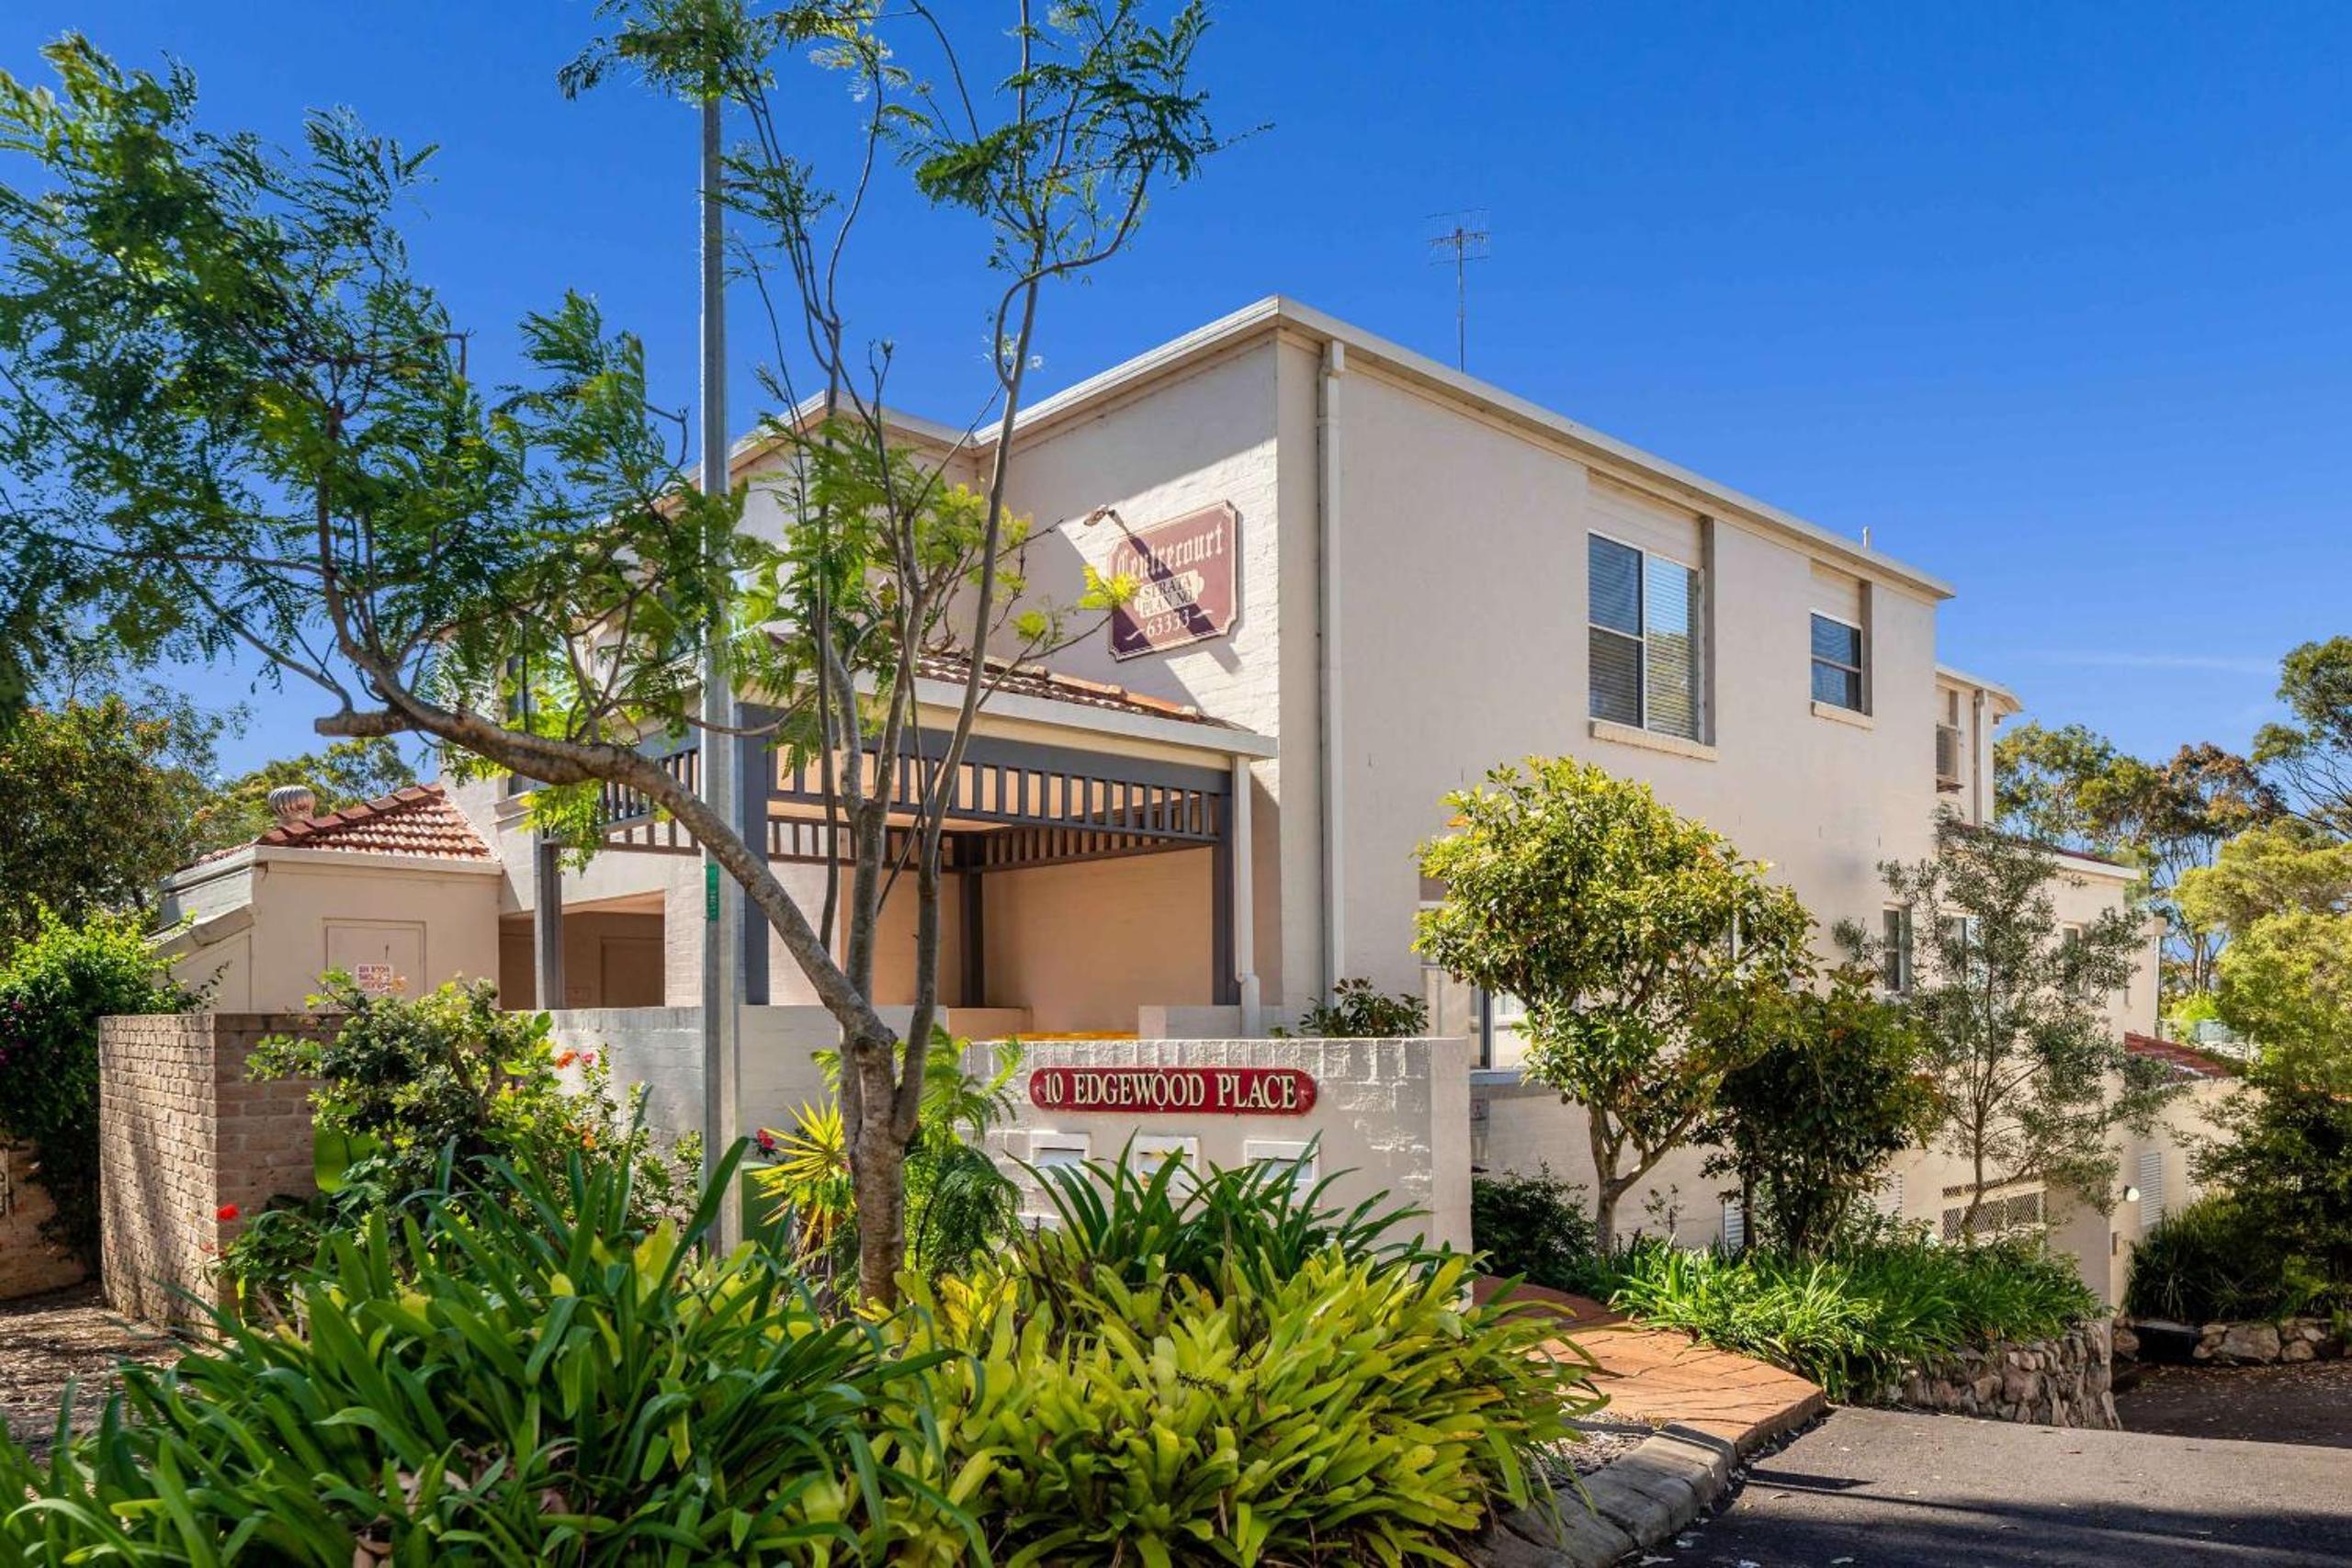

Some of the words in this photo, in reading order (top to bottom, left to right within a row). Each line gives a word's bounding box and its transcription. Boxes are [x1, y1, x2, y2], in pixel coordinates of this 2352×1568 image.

[1144, 574, 1192, 597] STRATA
[1147, 609, 1190, 637] 63333
[1044, 1073, 1064, 1103] 10
[1072, 1072, 1205, 1107] EDGEWOOD
[1216, 1074, 1298, 1110] PLACE
